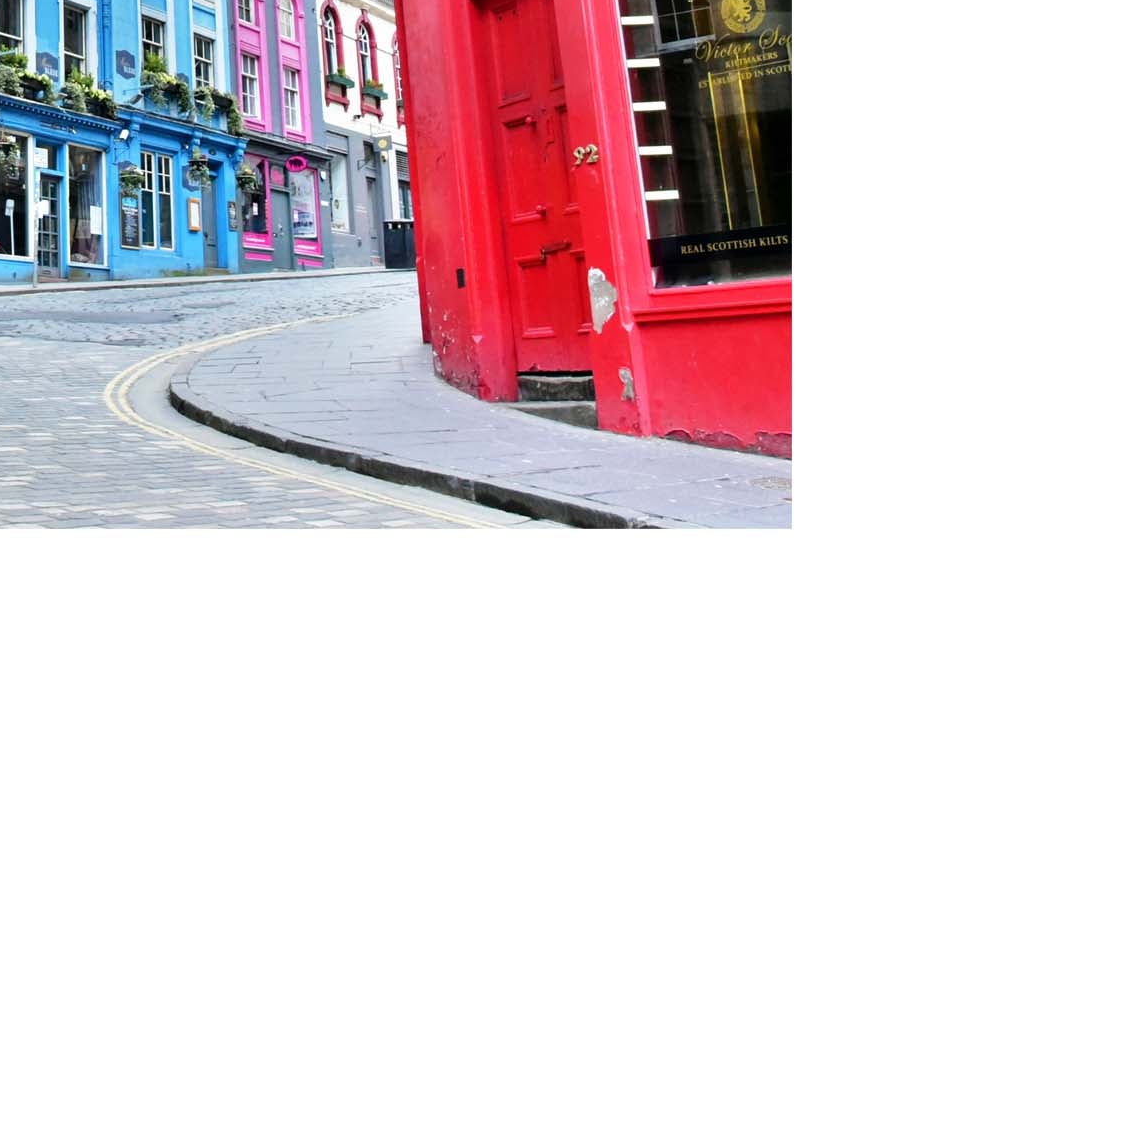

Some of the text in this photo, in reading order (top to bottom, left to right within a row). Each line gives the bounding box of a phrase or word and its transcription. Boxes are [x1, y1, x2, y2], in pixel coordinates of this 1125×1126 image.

[696, 33, 752, 63] Victor
[573, 144, 600, 166] 92
[681, 234, 788, 255] REAL SCOTTISH KILTS
